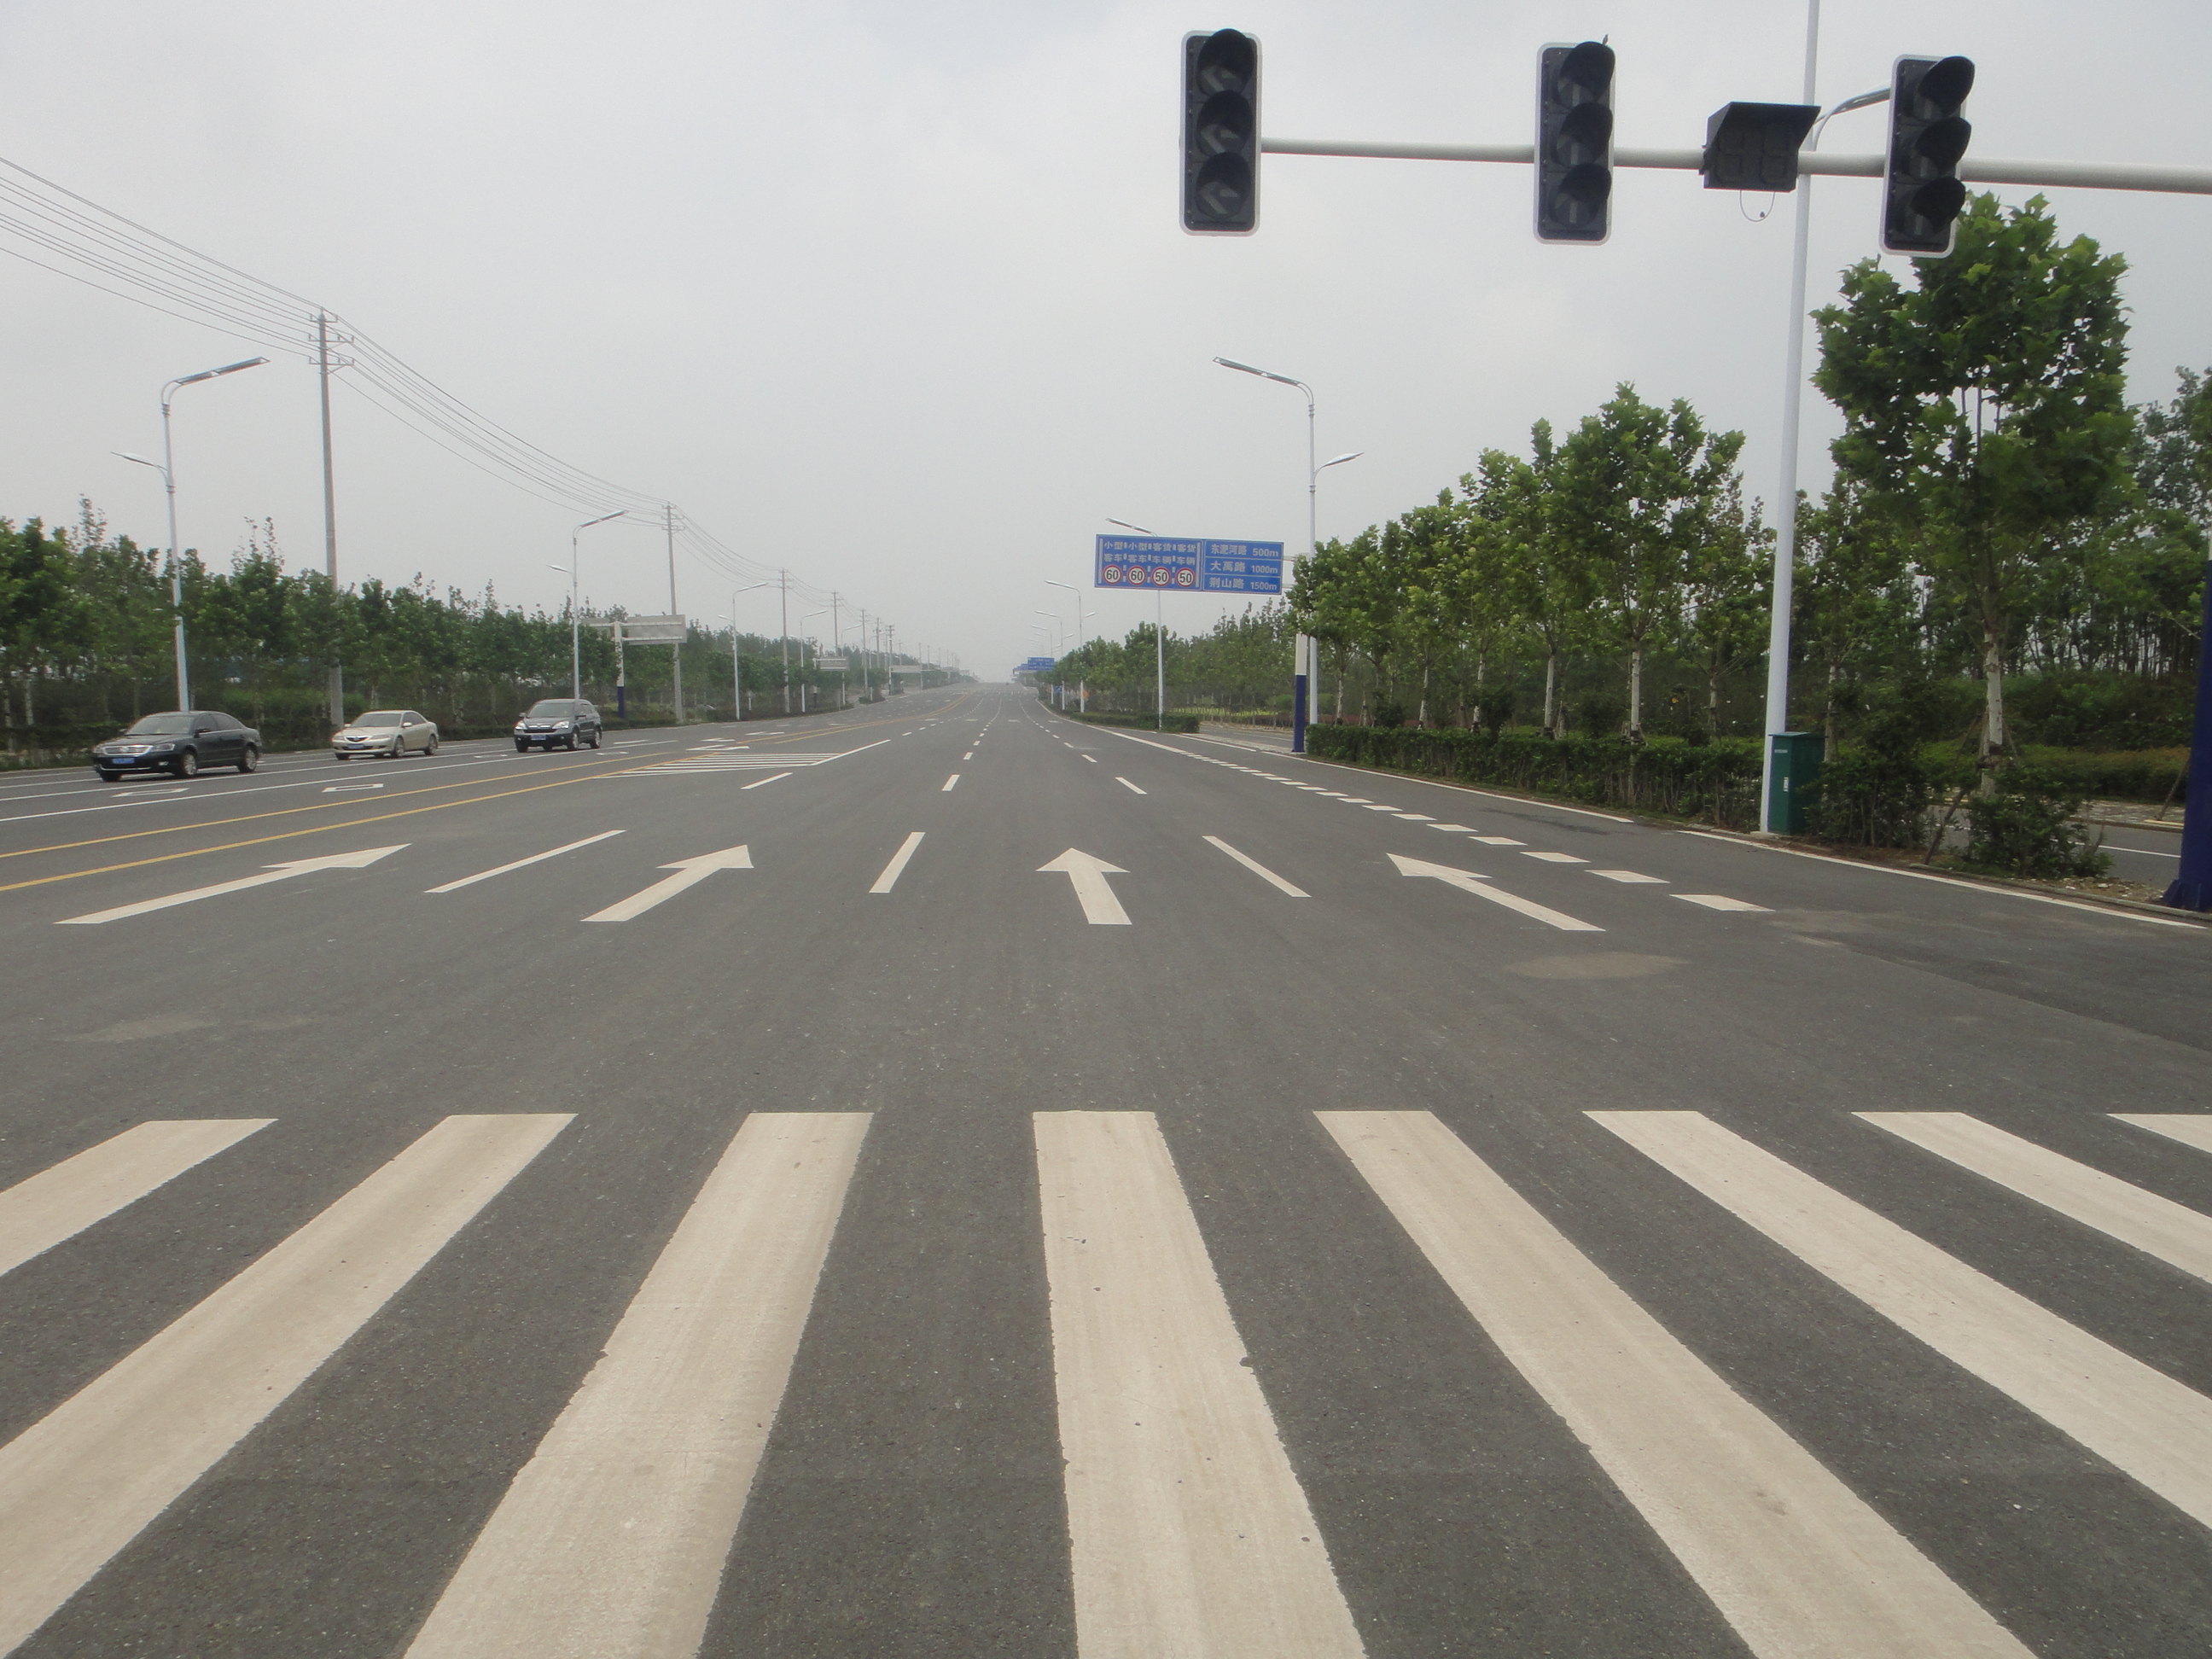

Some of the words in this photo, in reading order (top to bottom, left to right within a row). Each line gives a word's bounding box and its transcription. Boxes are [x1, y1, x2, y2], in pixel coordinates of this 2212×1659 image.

[1103, 541, 1123, 550] 小型
[1128, 542, 1147, 551] 小型
[1253, 548, 1278, 557] 500m
[1103, 553, 1123, 562] 客车
[1127, 554, 1147, 563] 客车
[1251, 565, 1278, 574] 1000m
[1106, 569, 1119, 580] 60
[1130, 570, 1144, 581] 60
[1155, 571, 1168, 582] 50
[1179, 573, 1192, 584] 50
[1209, 577, 1245, 589] 荆山路
[1250, 581, 1278, 591] 1500m
